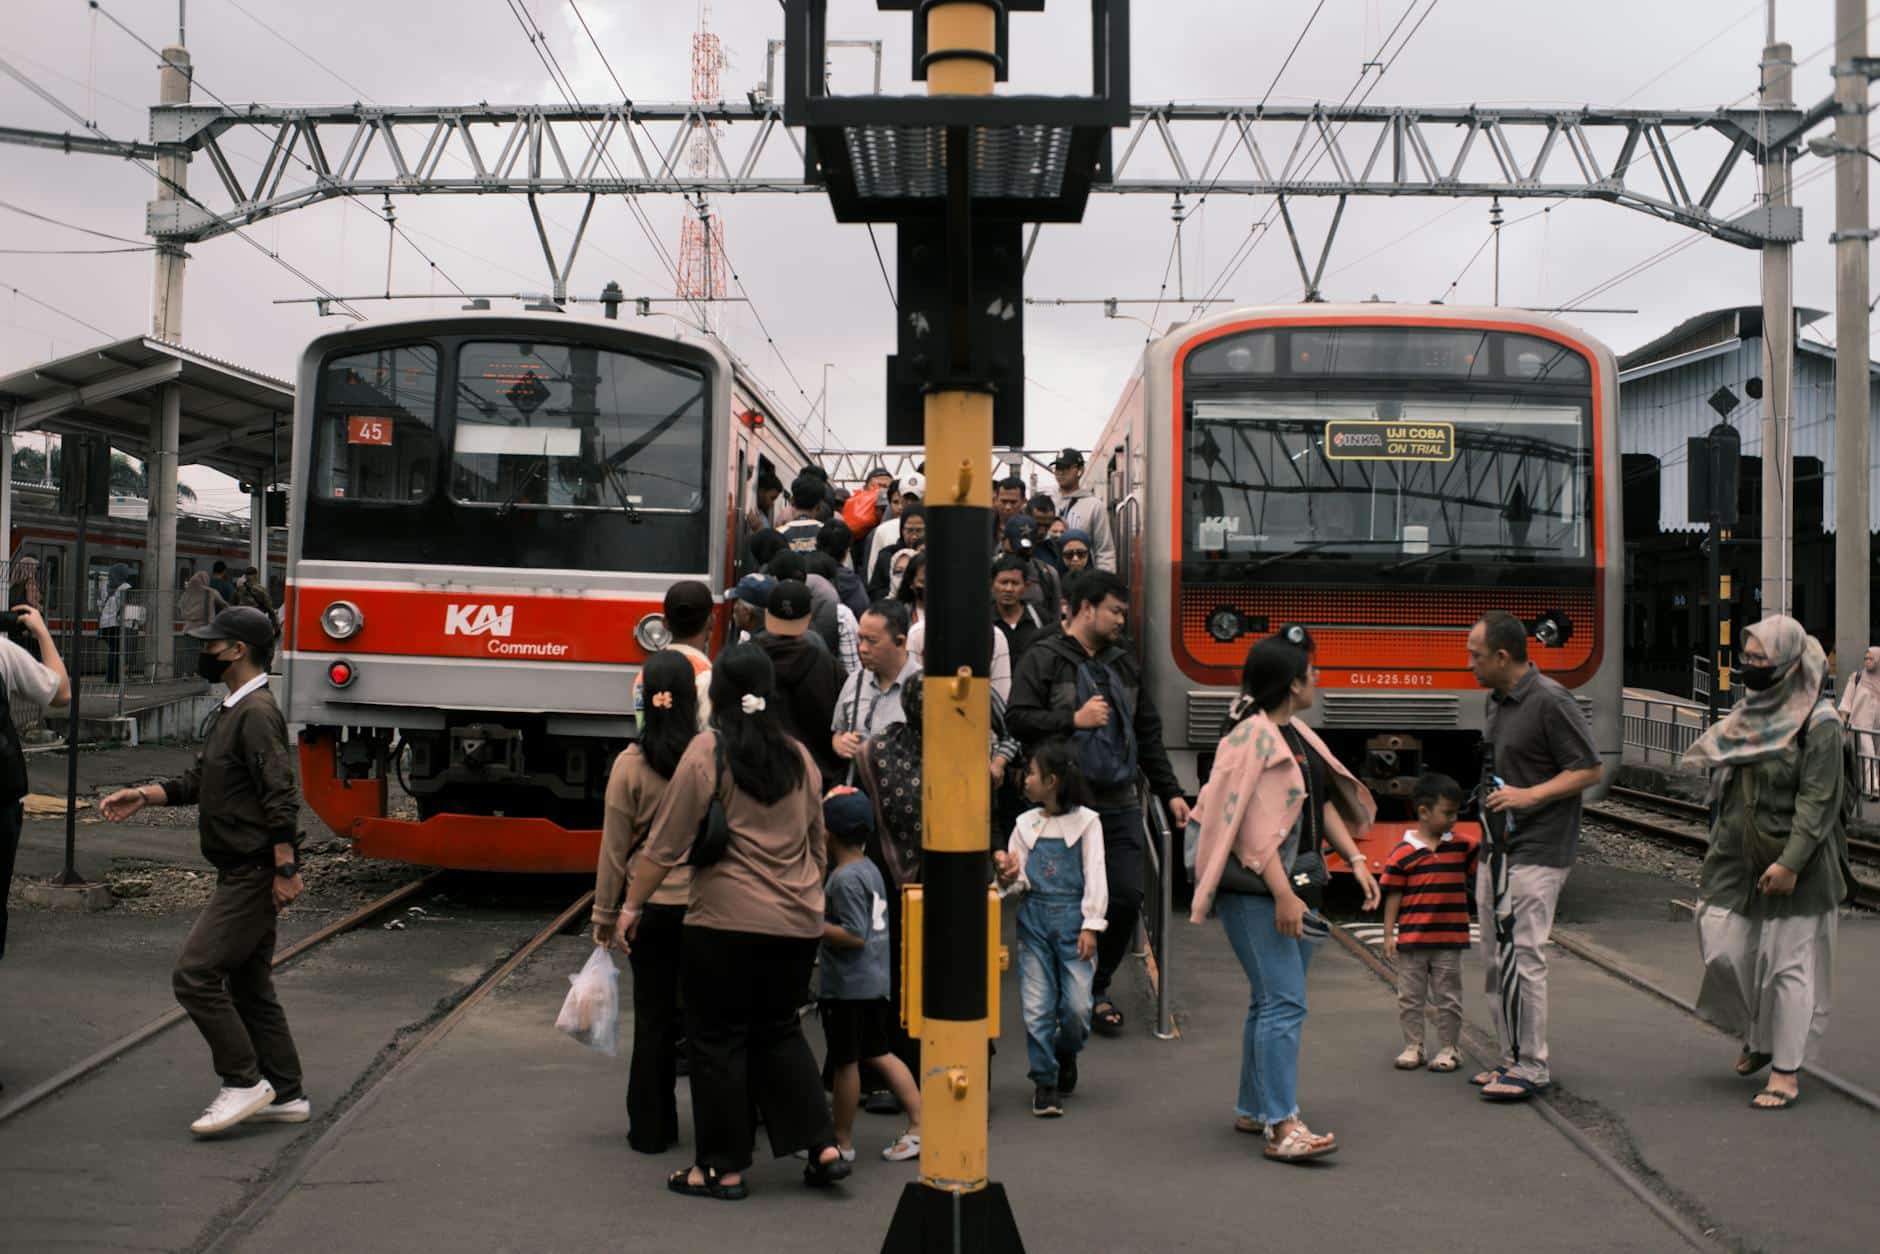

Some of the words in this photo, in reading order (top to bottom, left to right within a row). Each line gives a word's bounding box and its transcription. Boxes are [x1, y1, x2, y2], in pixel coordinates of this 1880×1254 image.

[360, 423, 382, 440] 45
[1386, 427, 1406, 438] UJI
[1408, 428, 1446, 439] COBA
[1387, 444, 1407, 454] ON
[1409, 444, 1443, 455] TRIAL
[444, 604, 514, 636] KAI
[487, 639, 568, 656] Commuter
[1350, 673, 1433, 685] CLI-225.5012
